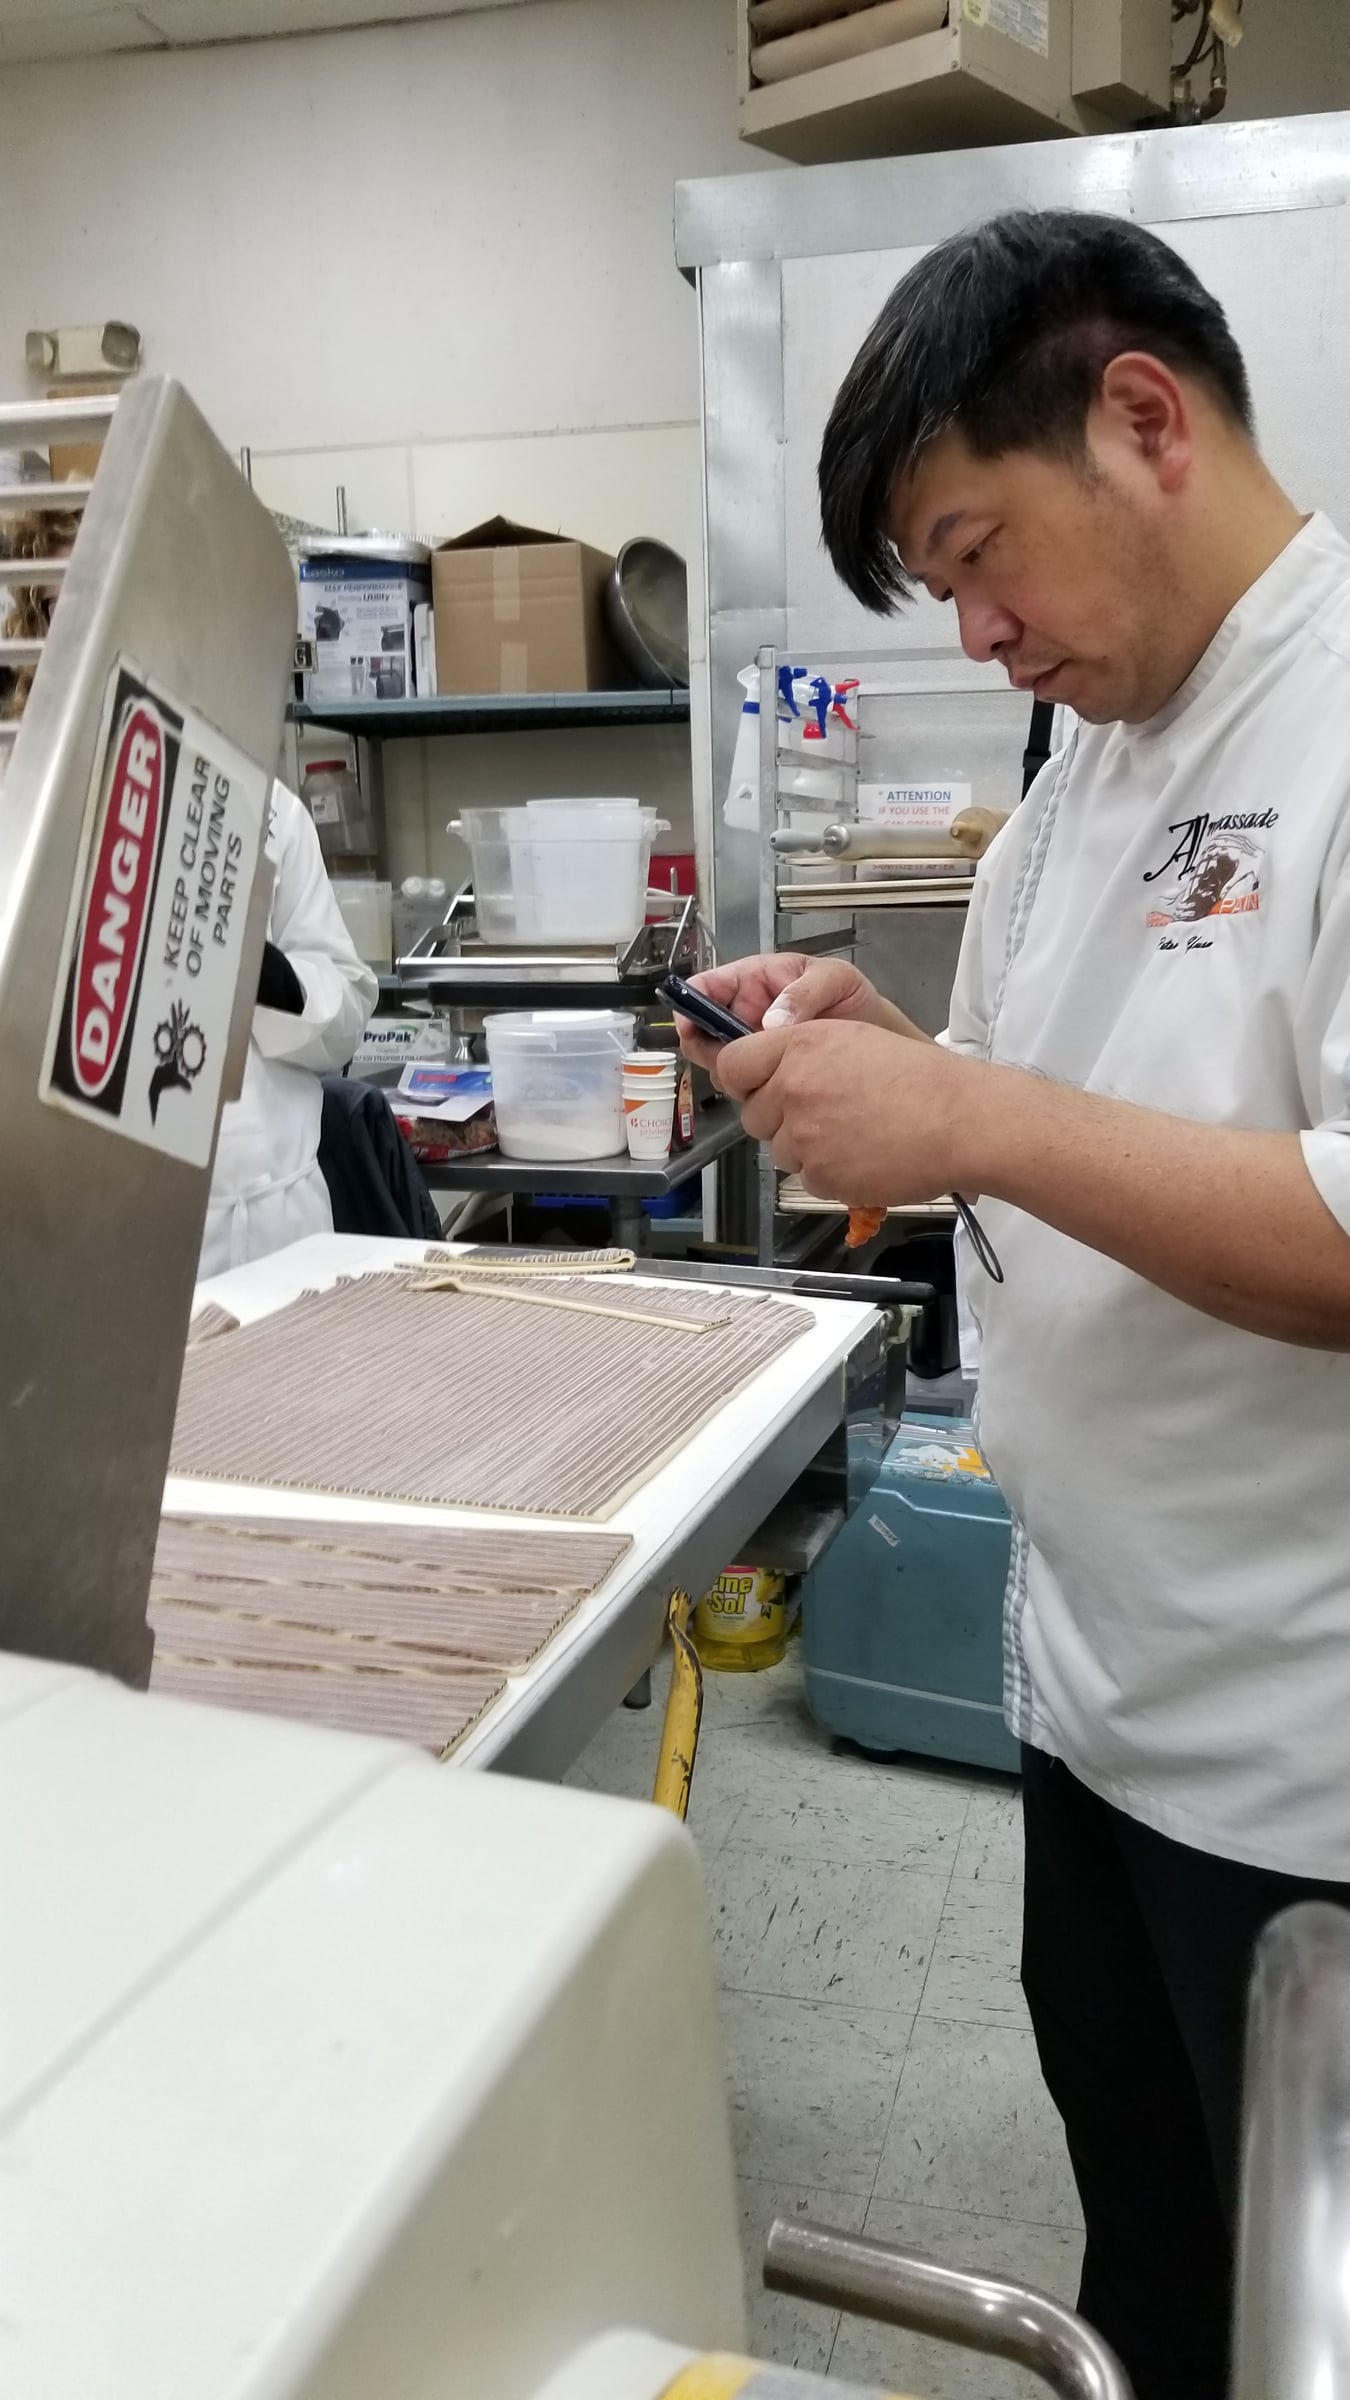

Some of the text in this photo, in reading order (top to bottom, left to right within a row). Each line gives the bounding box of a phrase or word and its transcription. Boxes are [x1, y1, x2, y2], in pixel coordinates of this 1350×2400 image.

[878, 806, 950, 815] IF YOU USE THE
[887, 790, 951, 801] ATTENTION
[164, 756, 211, 970] KEEP CLEAR
[186, 773, 231, 978] OF MOVING
[213, 832, 242, 948] PARTS
[80, 729, 158, 1065] DANGER
[363, 1031, 412, 1043] ProPak
[715, 1576, 754, 1594] ine
